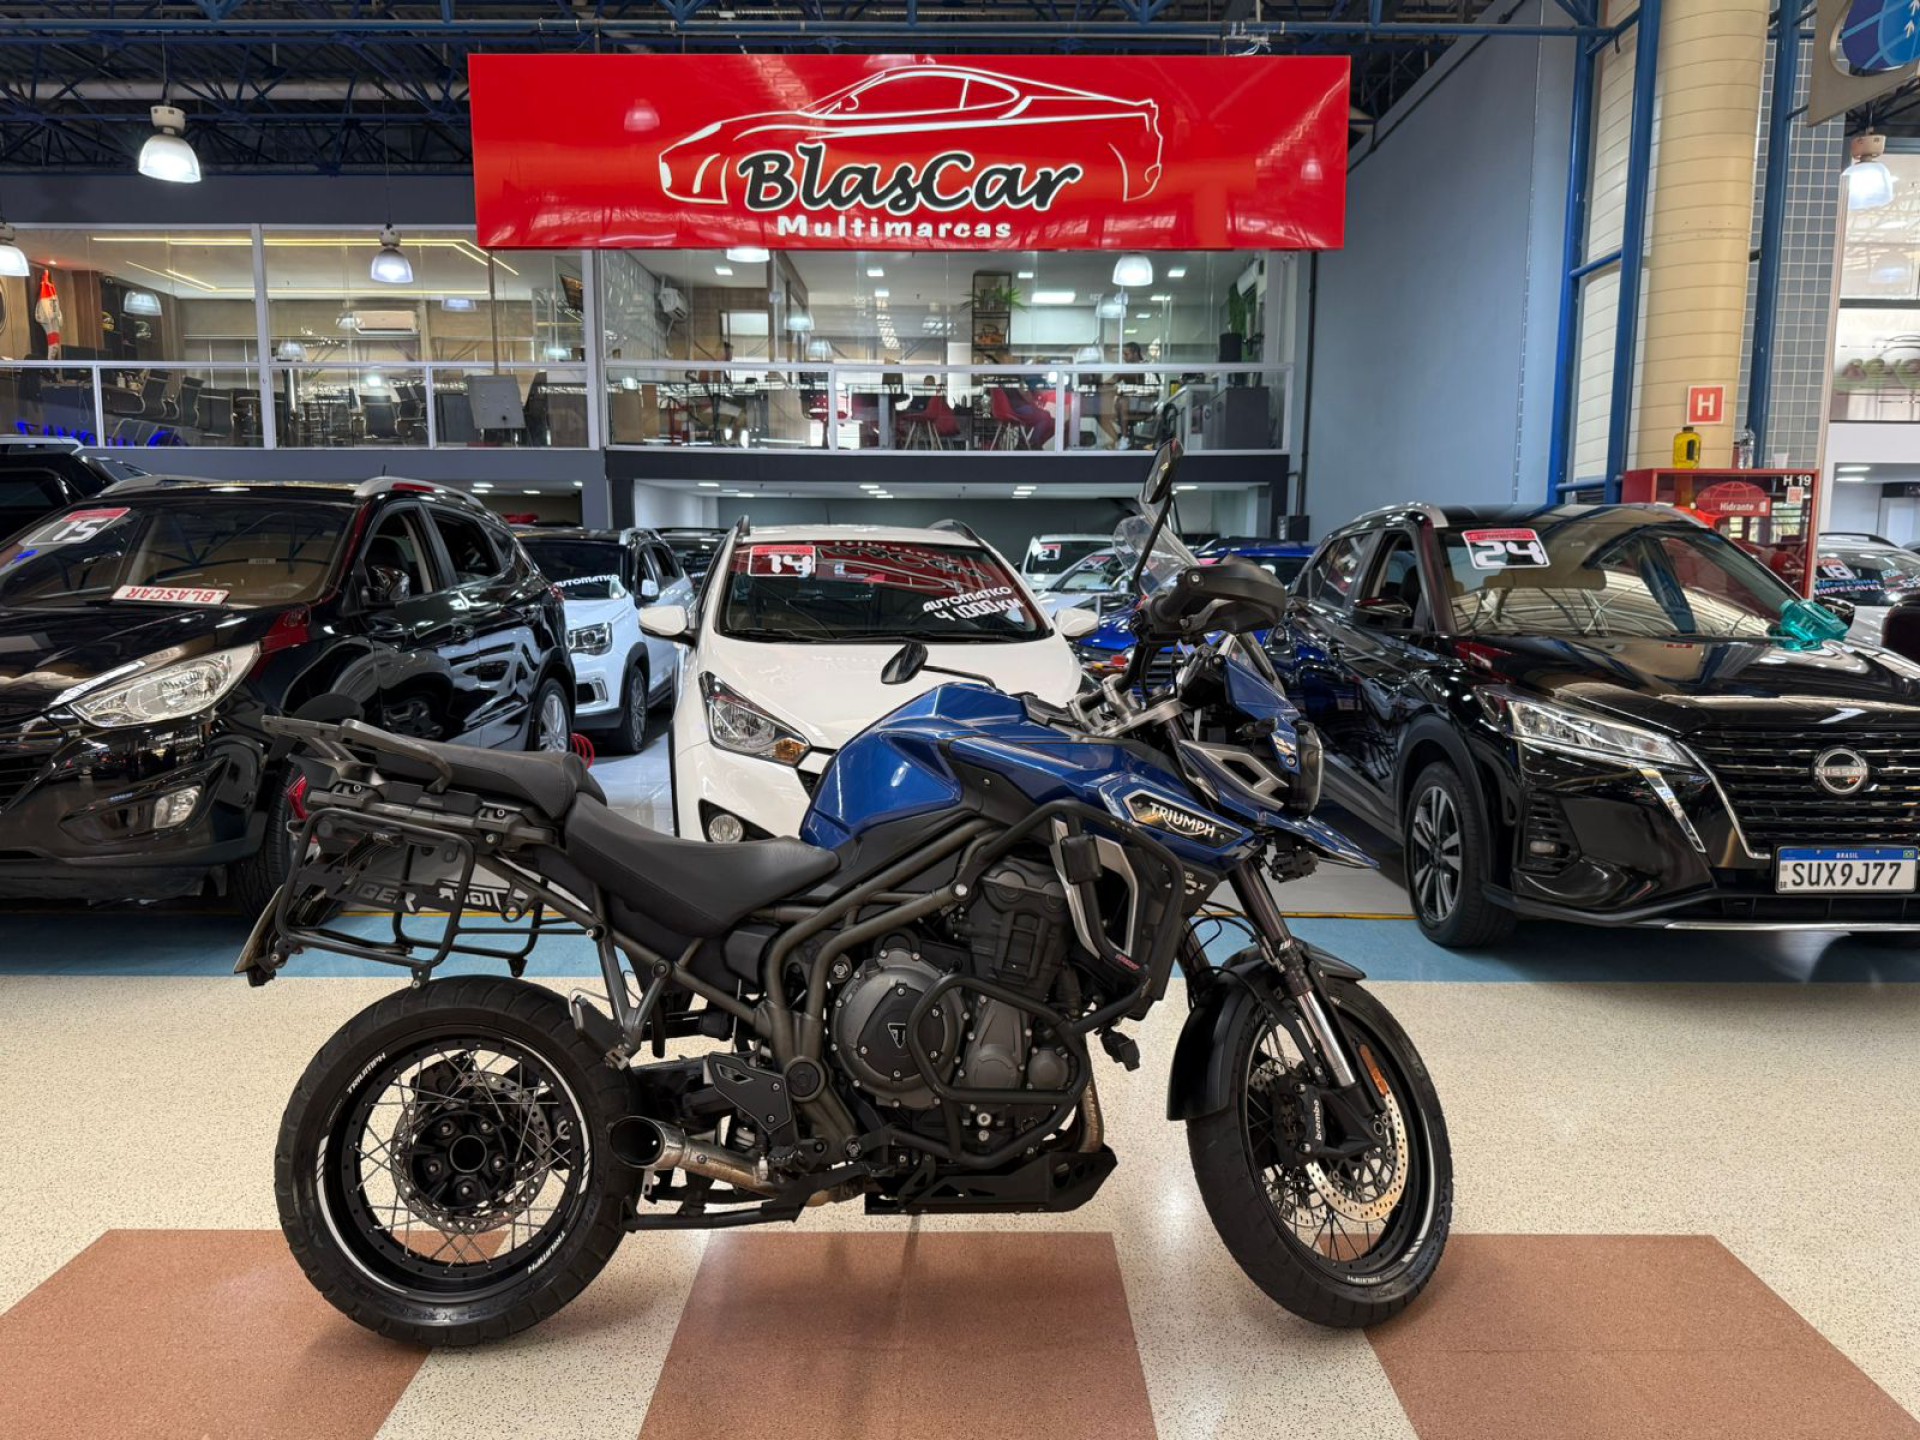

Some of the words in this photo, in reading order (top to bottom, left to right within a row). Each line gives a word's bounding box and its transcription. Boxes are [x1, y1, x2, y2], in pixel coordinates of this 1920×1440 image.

[738, 142, 1083, 215] BlasCar
[777, 215, 1012, 238] Multimarcas
[1697, 393, 1715, 416] H
[1783, 475, 1793, 486] H
[1797, 475, 1812, 486] 19
[1719, 502, 1754, 512] Hidrante
[53, 519, 100, 541] 15
[1475, 541, 1545, 566] 24
[125, 587, 217, 603] BLASCAR
[922, 586, 1012, 612] AUTOMATICO
[1816, 767, 1867, 775] NISSAN
[1149, 801, 1216, 838] TRIUMPH
[1791, 862, 1902, 887] SUX9J77
[1313, 1099, 1322, 1141] brembo
